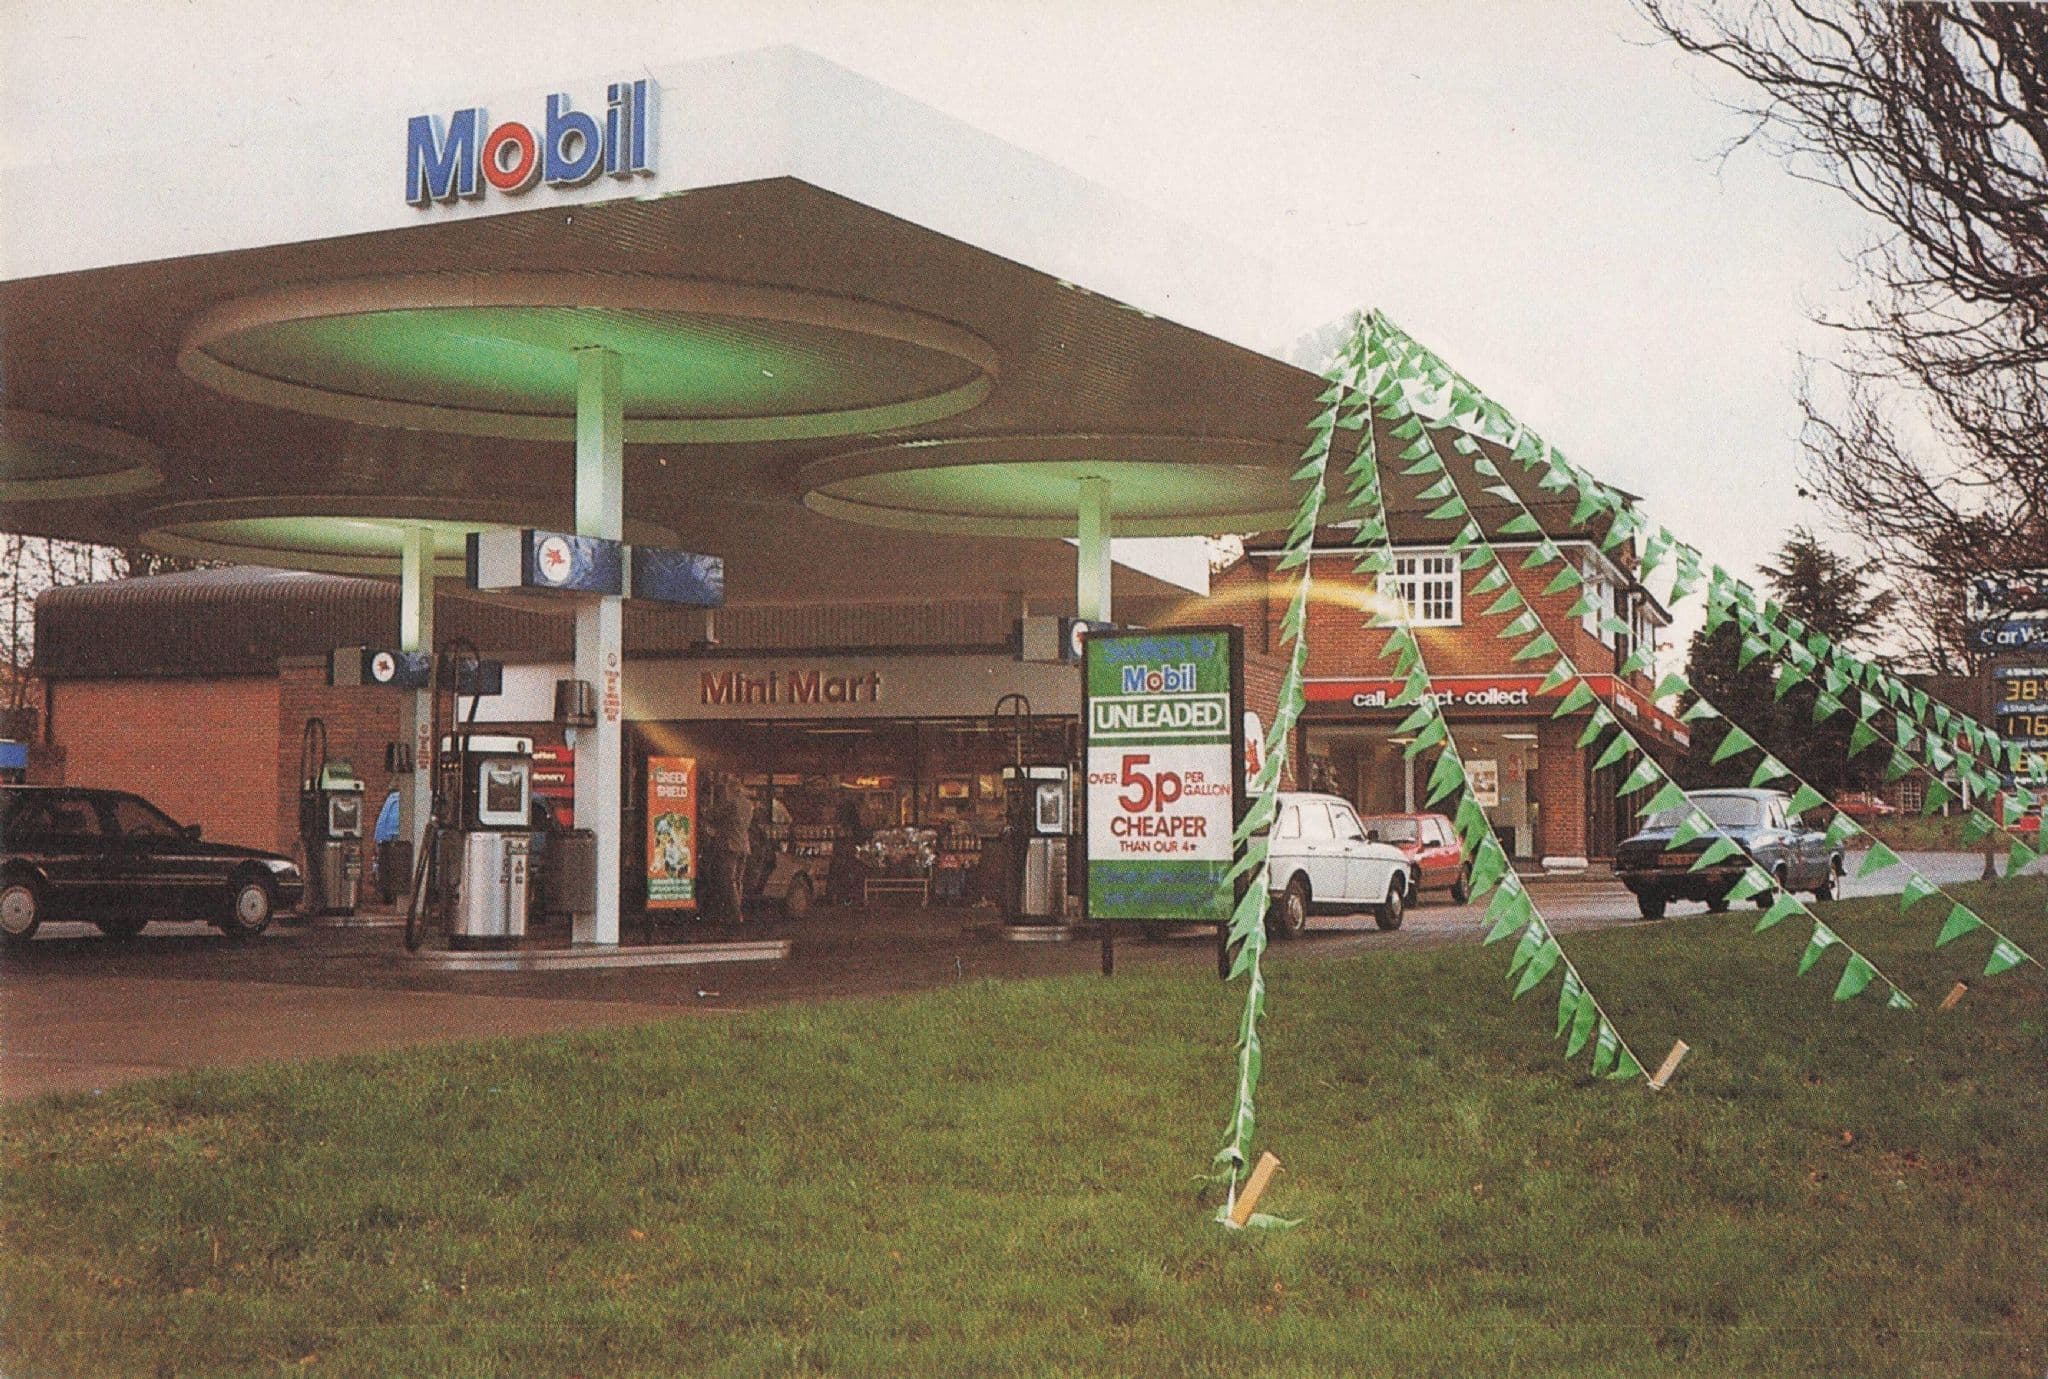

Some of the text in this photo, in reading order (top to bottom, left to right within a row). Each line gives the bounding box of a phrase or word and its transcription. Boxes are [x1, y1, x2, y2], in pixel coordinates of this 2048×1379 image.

[405, 79, 656, 203] Mobil
[701, 670, 880, 704] Mini Mart
[1122, 663, 1197, 693] Mobil
[1353, 690, 1386, 706] call
[1464, 688, 1528, 705] collect
[1096, 701, 1223, 729] UNLEADED
[656, 770, 688, 784] GREEN
[1088, 754, 1183, 812] OVER 5p
[1184, 771, 1205, 782] PER
[656, 784, 688, 798] SHIELD
[1183, 784, 1231, 796] GALLON
[1110, 816, 1207, 838] CHEAPER
[1120, 840, 1151, 852] THAN
[1154, 840, 1178, 852] OUR
